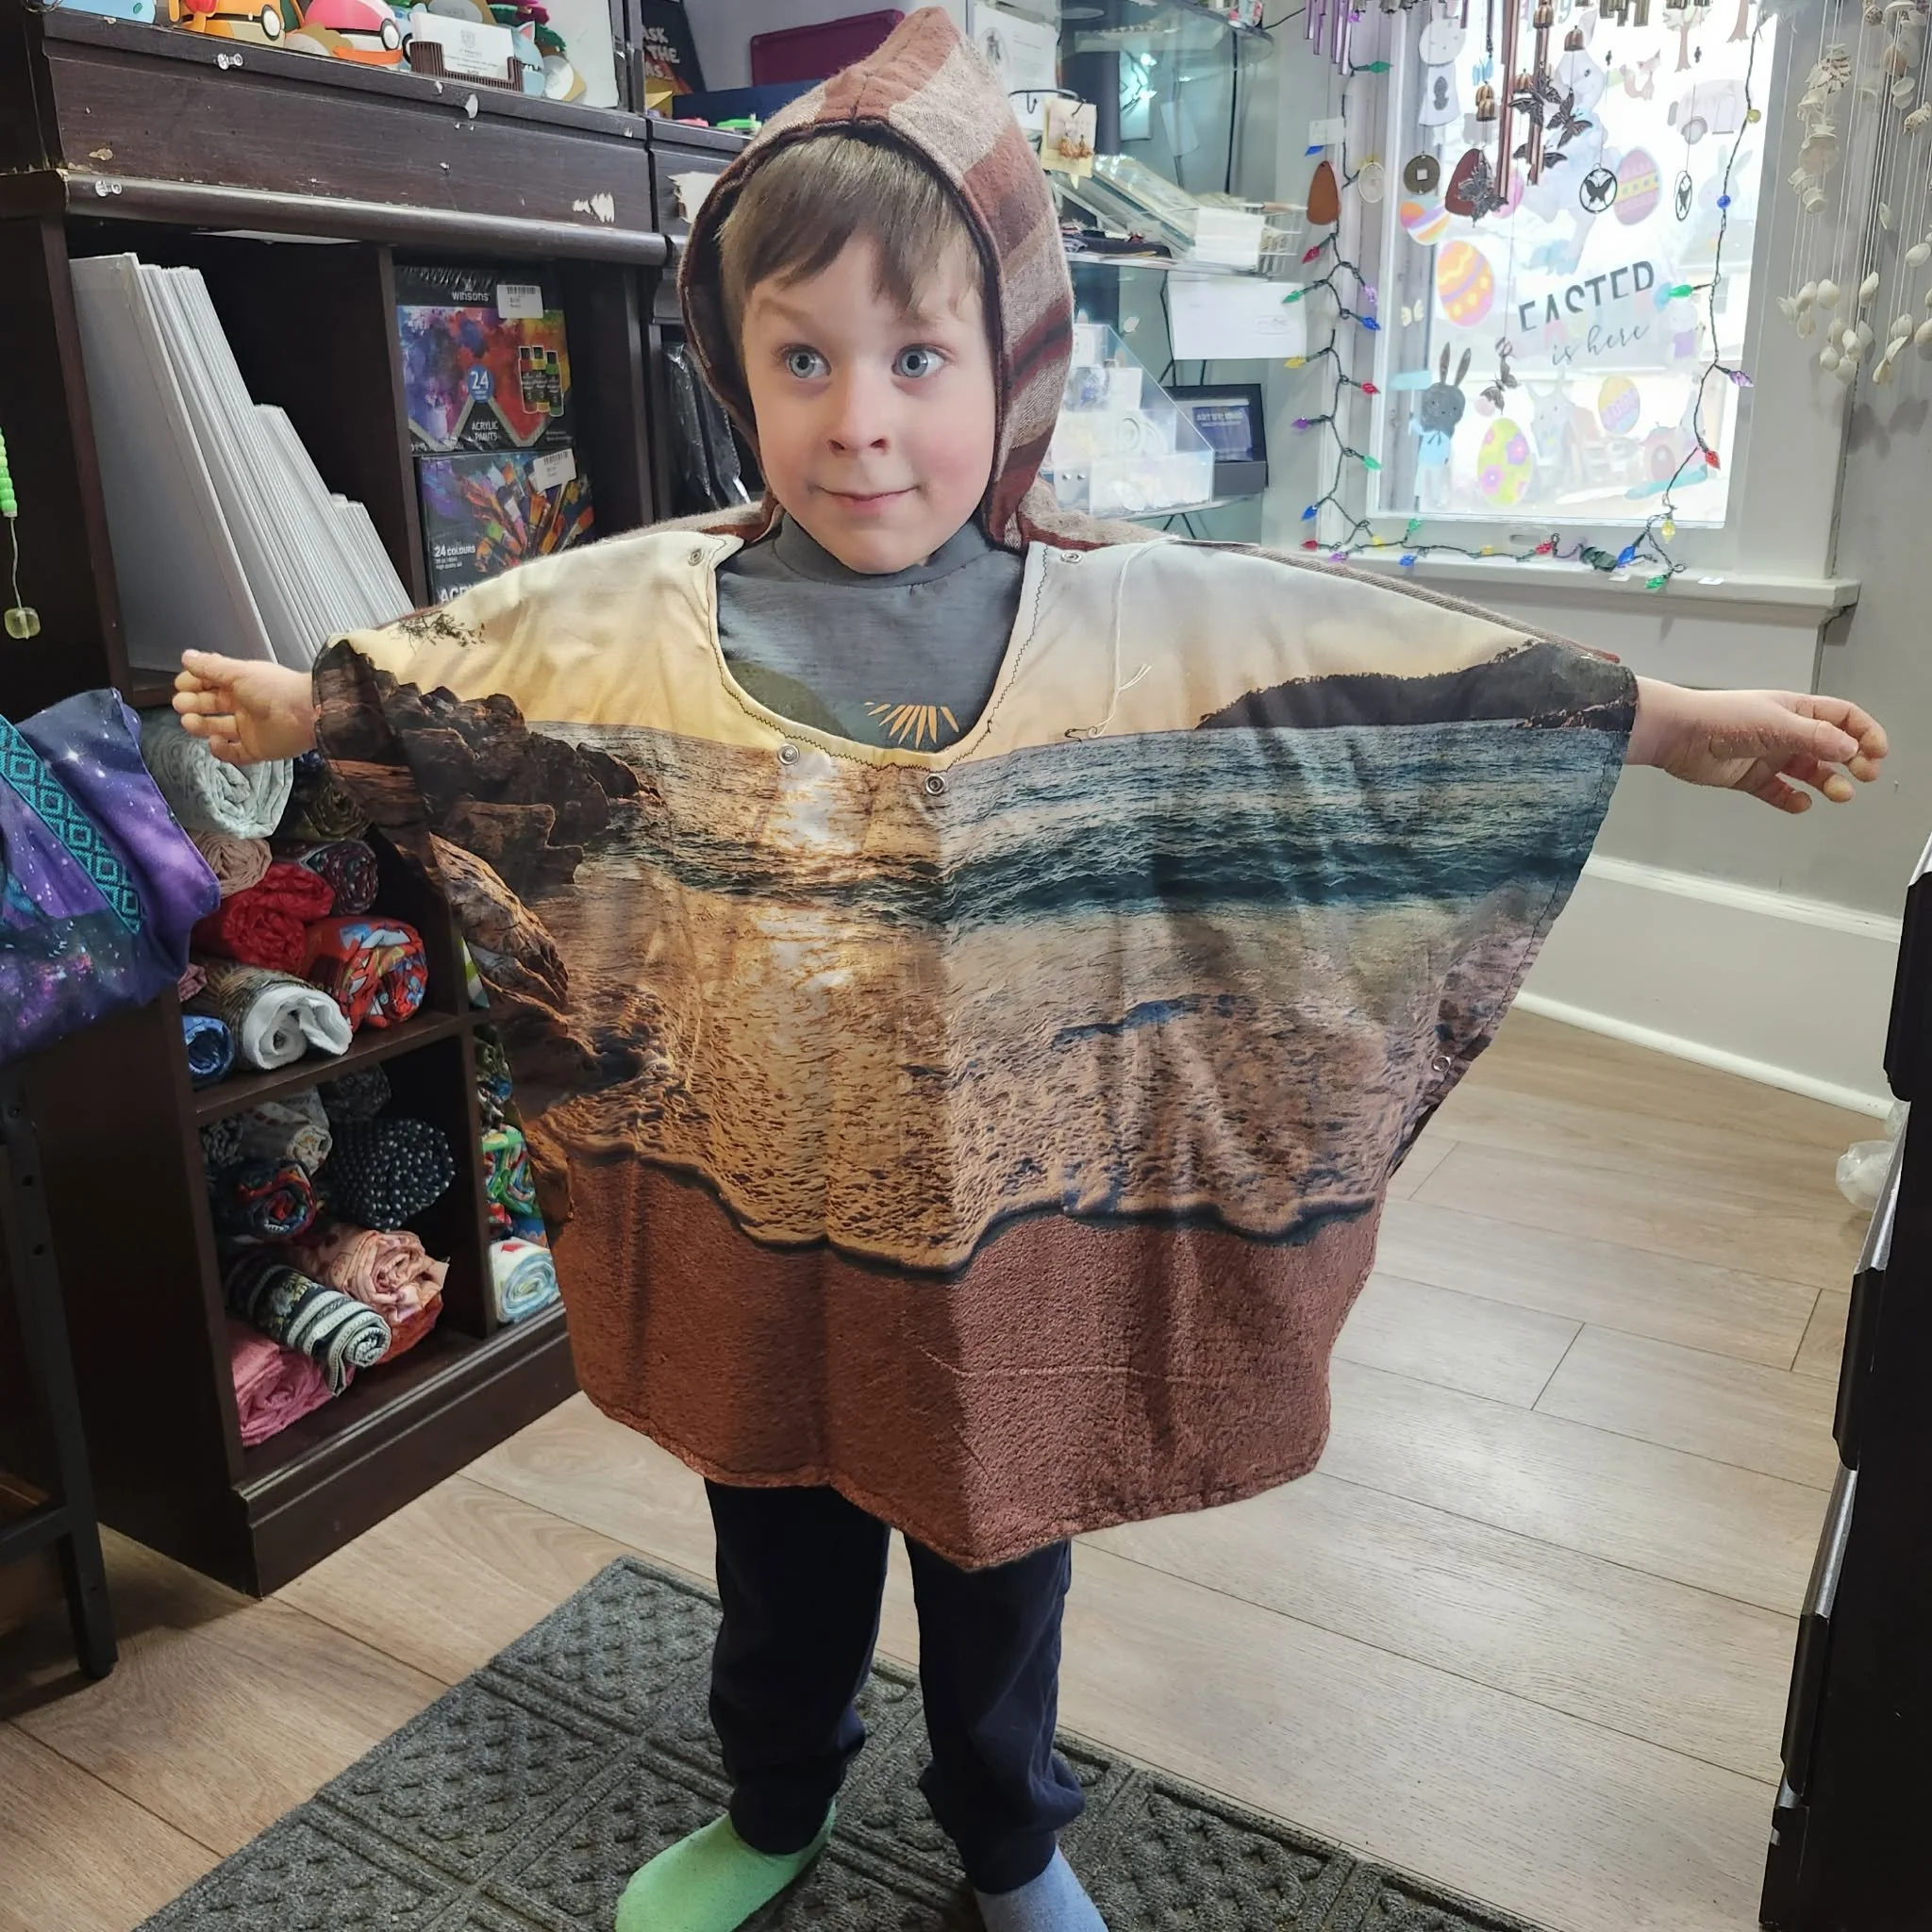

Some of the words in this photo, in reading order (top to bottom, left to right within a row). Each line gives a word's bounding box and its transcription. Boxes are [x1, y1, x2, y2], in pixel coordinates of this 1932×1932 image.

[645, 45, 680, 63] THE
[1588, 325, 1650, 356] here
[471, 369, 490, 390] 24
[472, 421, 498, 430] ACRYLIC
[434, 544, 446, 558] 24
[447, 544, 475, 556] COLOURS
